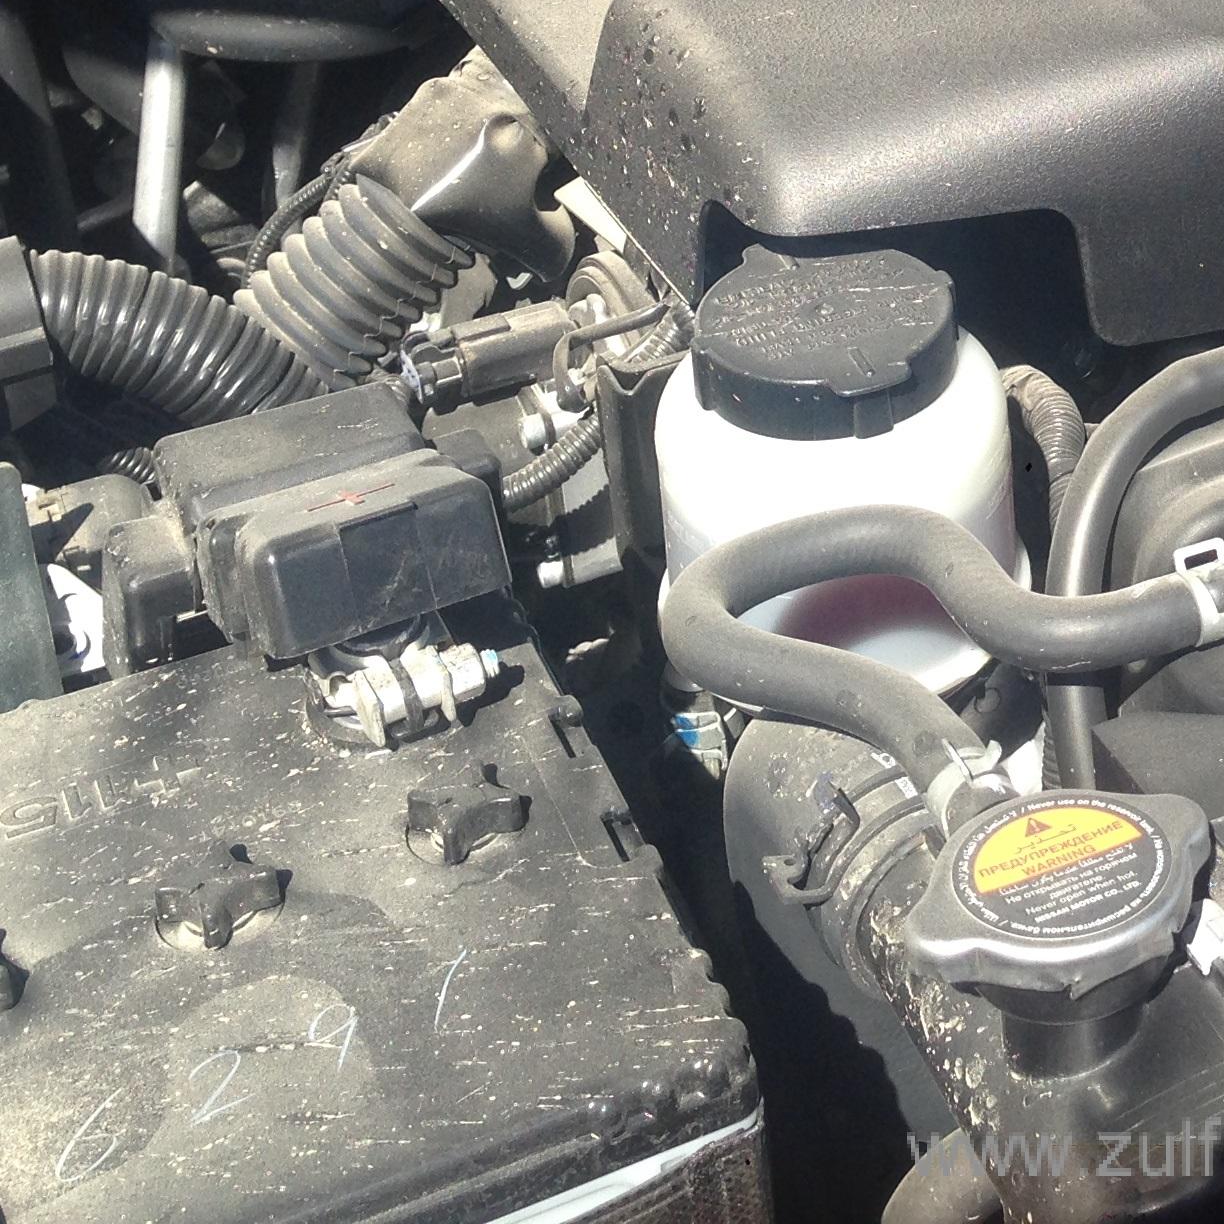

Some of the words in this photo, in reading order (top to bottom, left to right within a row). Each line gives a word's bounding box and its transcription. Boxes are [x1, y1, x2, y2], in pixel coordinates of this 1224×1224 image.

[1077, 798, 1090, 806] on
[1091, 798, 1107, 808] the
[978, 819, 1123, 878] ПРЕДУПРЕЖДЕНИЕ
[1022, 843, 1097, 876] WARNING
[1025, 900, 1057, 916] Never
